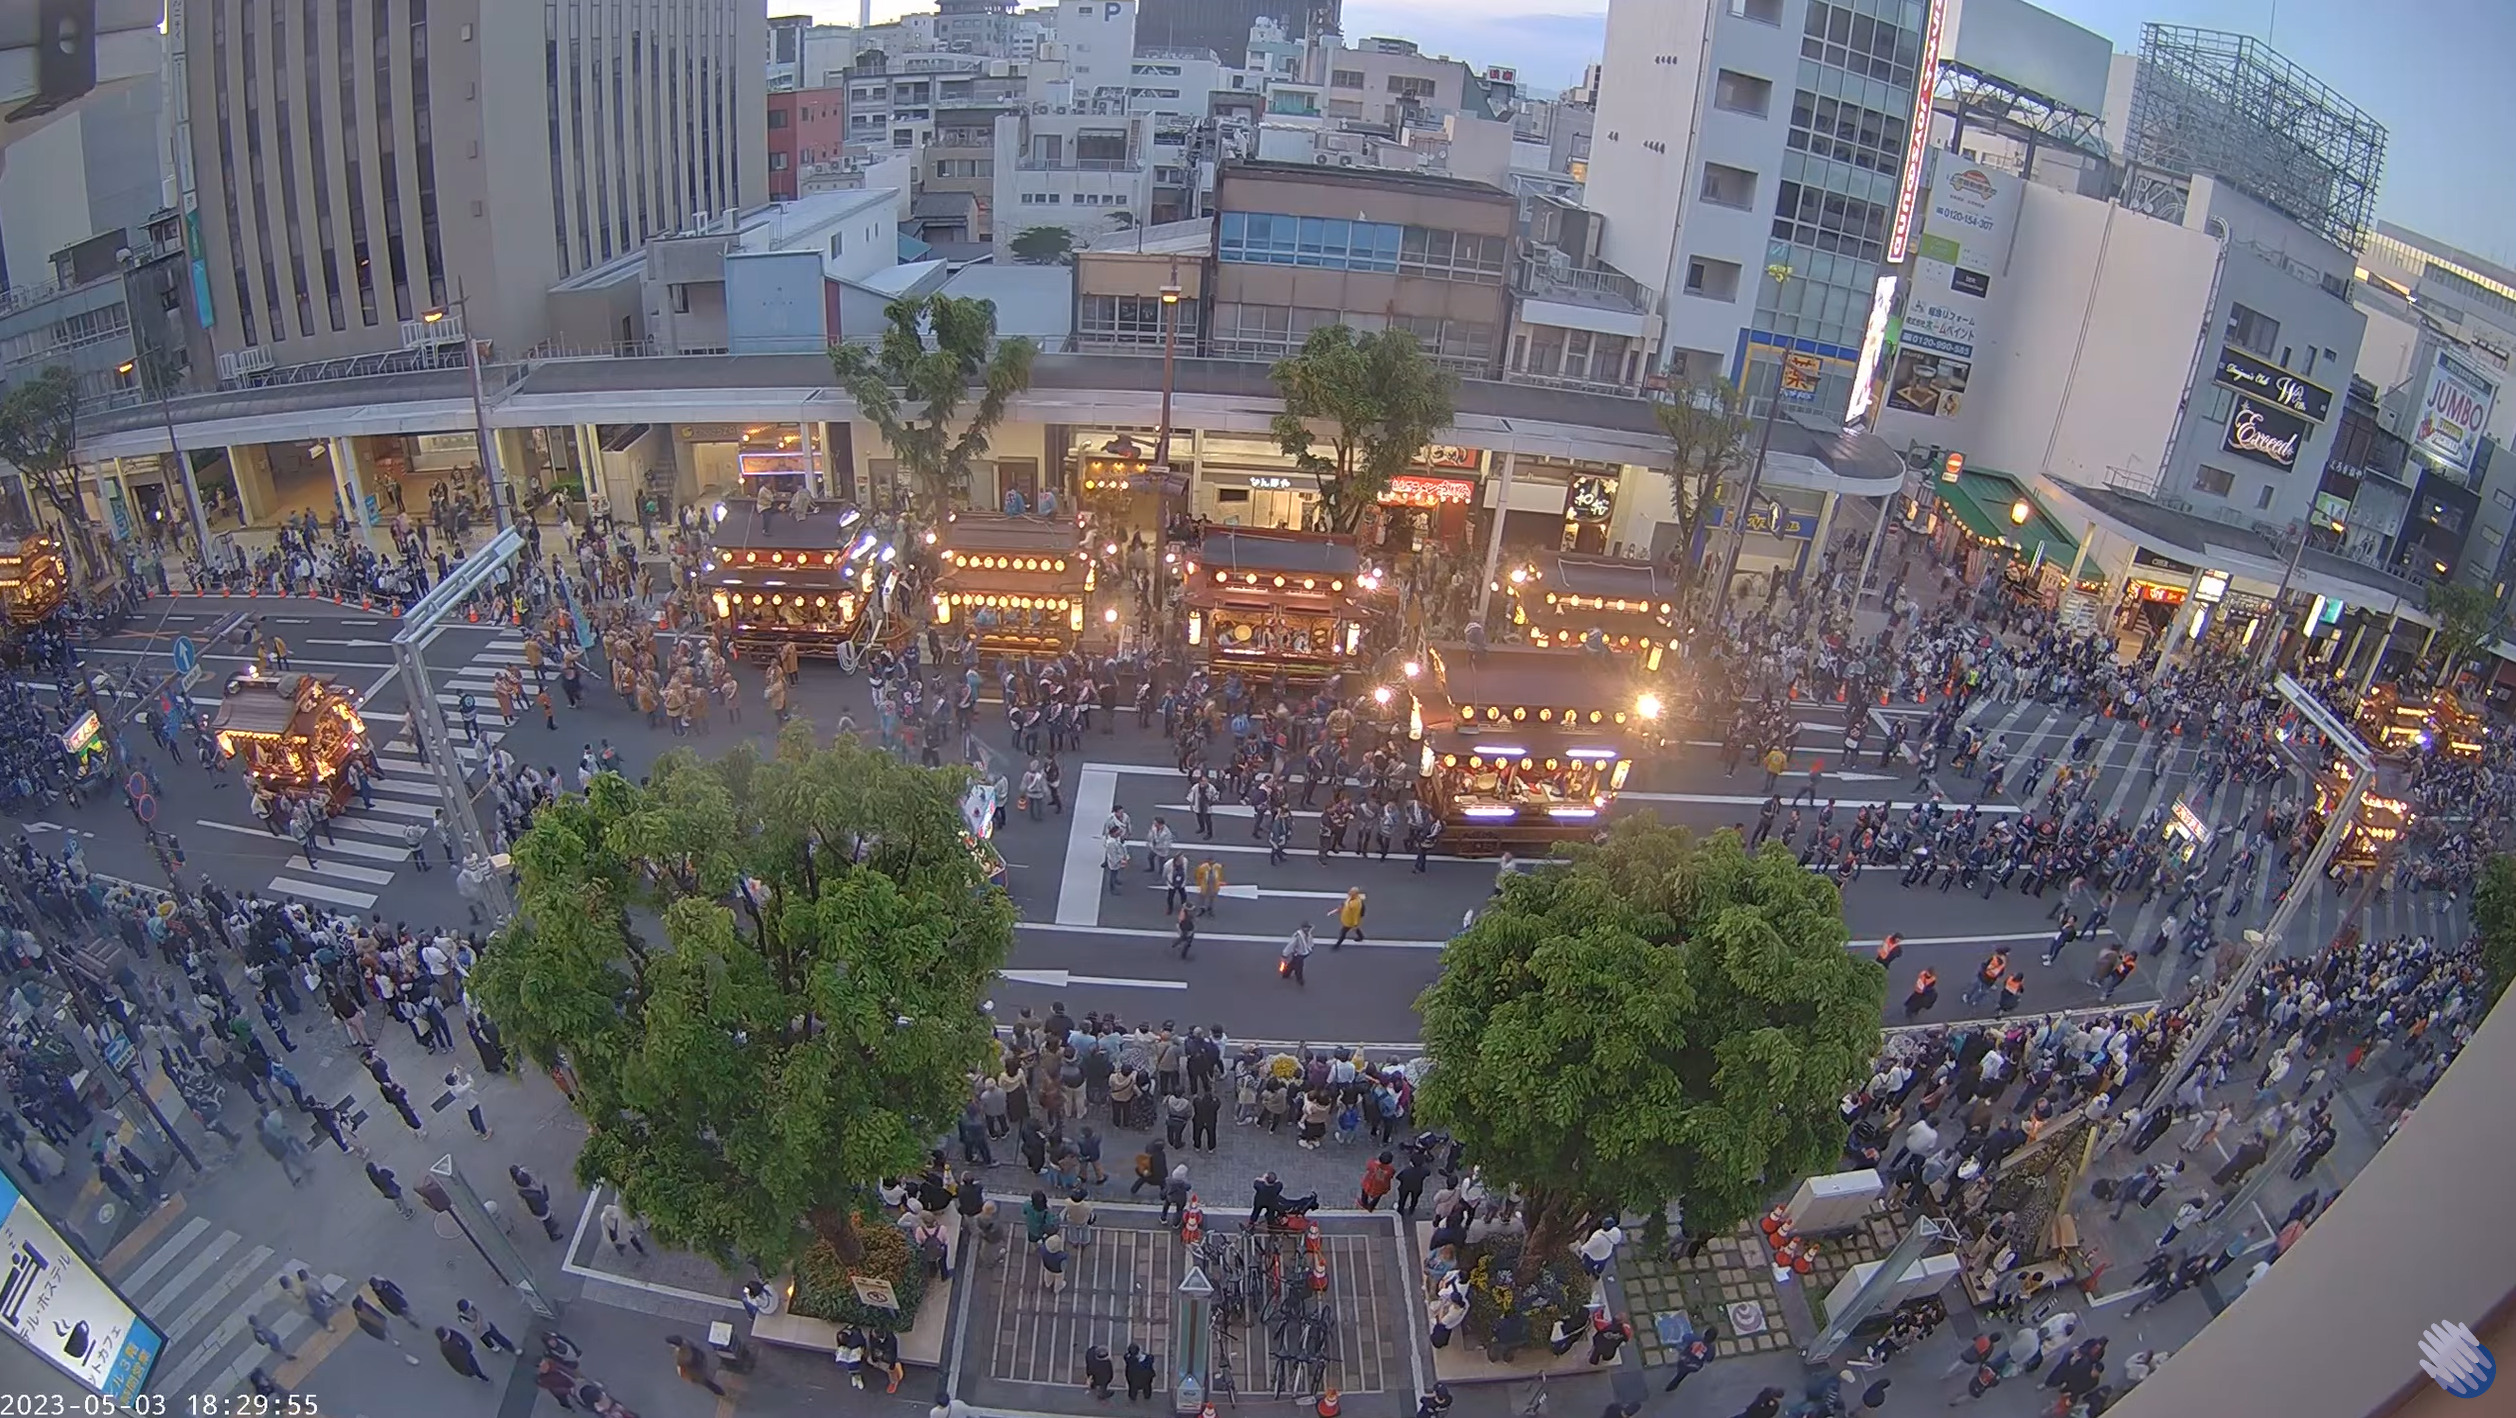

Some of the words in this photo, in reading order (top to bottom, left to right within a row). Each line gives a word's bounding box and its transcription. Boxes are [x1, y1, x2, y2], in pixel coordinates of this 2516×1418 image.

[1105, 2, 1121, 21] P
[1893, 97, 1927, 256] JOYSOUND
[1944, 208, 1994, 231] 0120-154-307
[2426, 379, 2484, 432] JUMBO
[2235, 409, 2298, 459] Exceed
